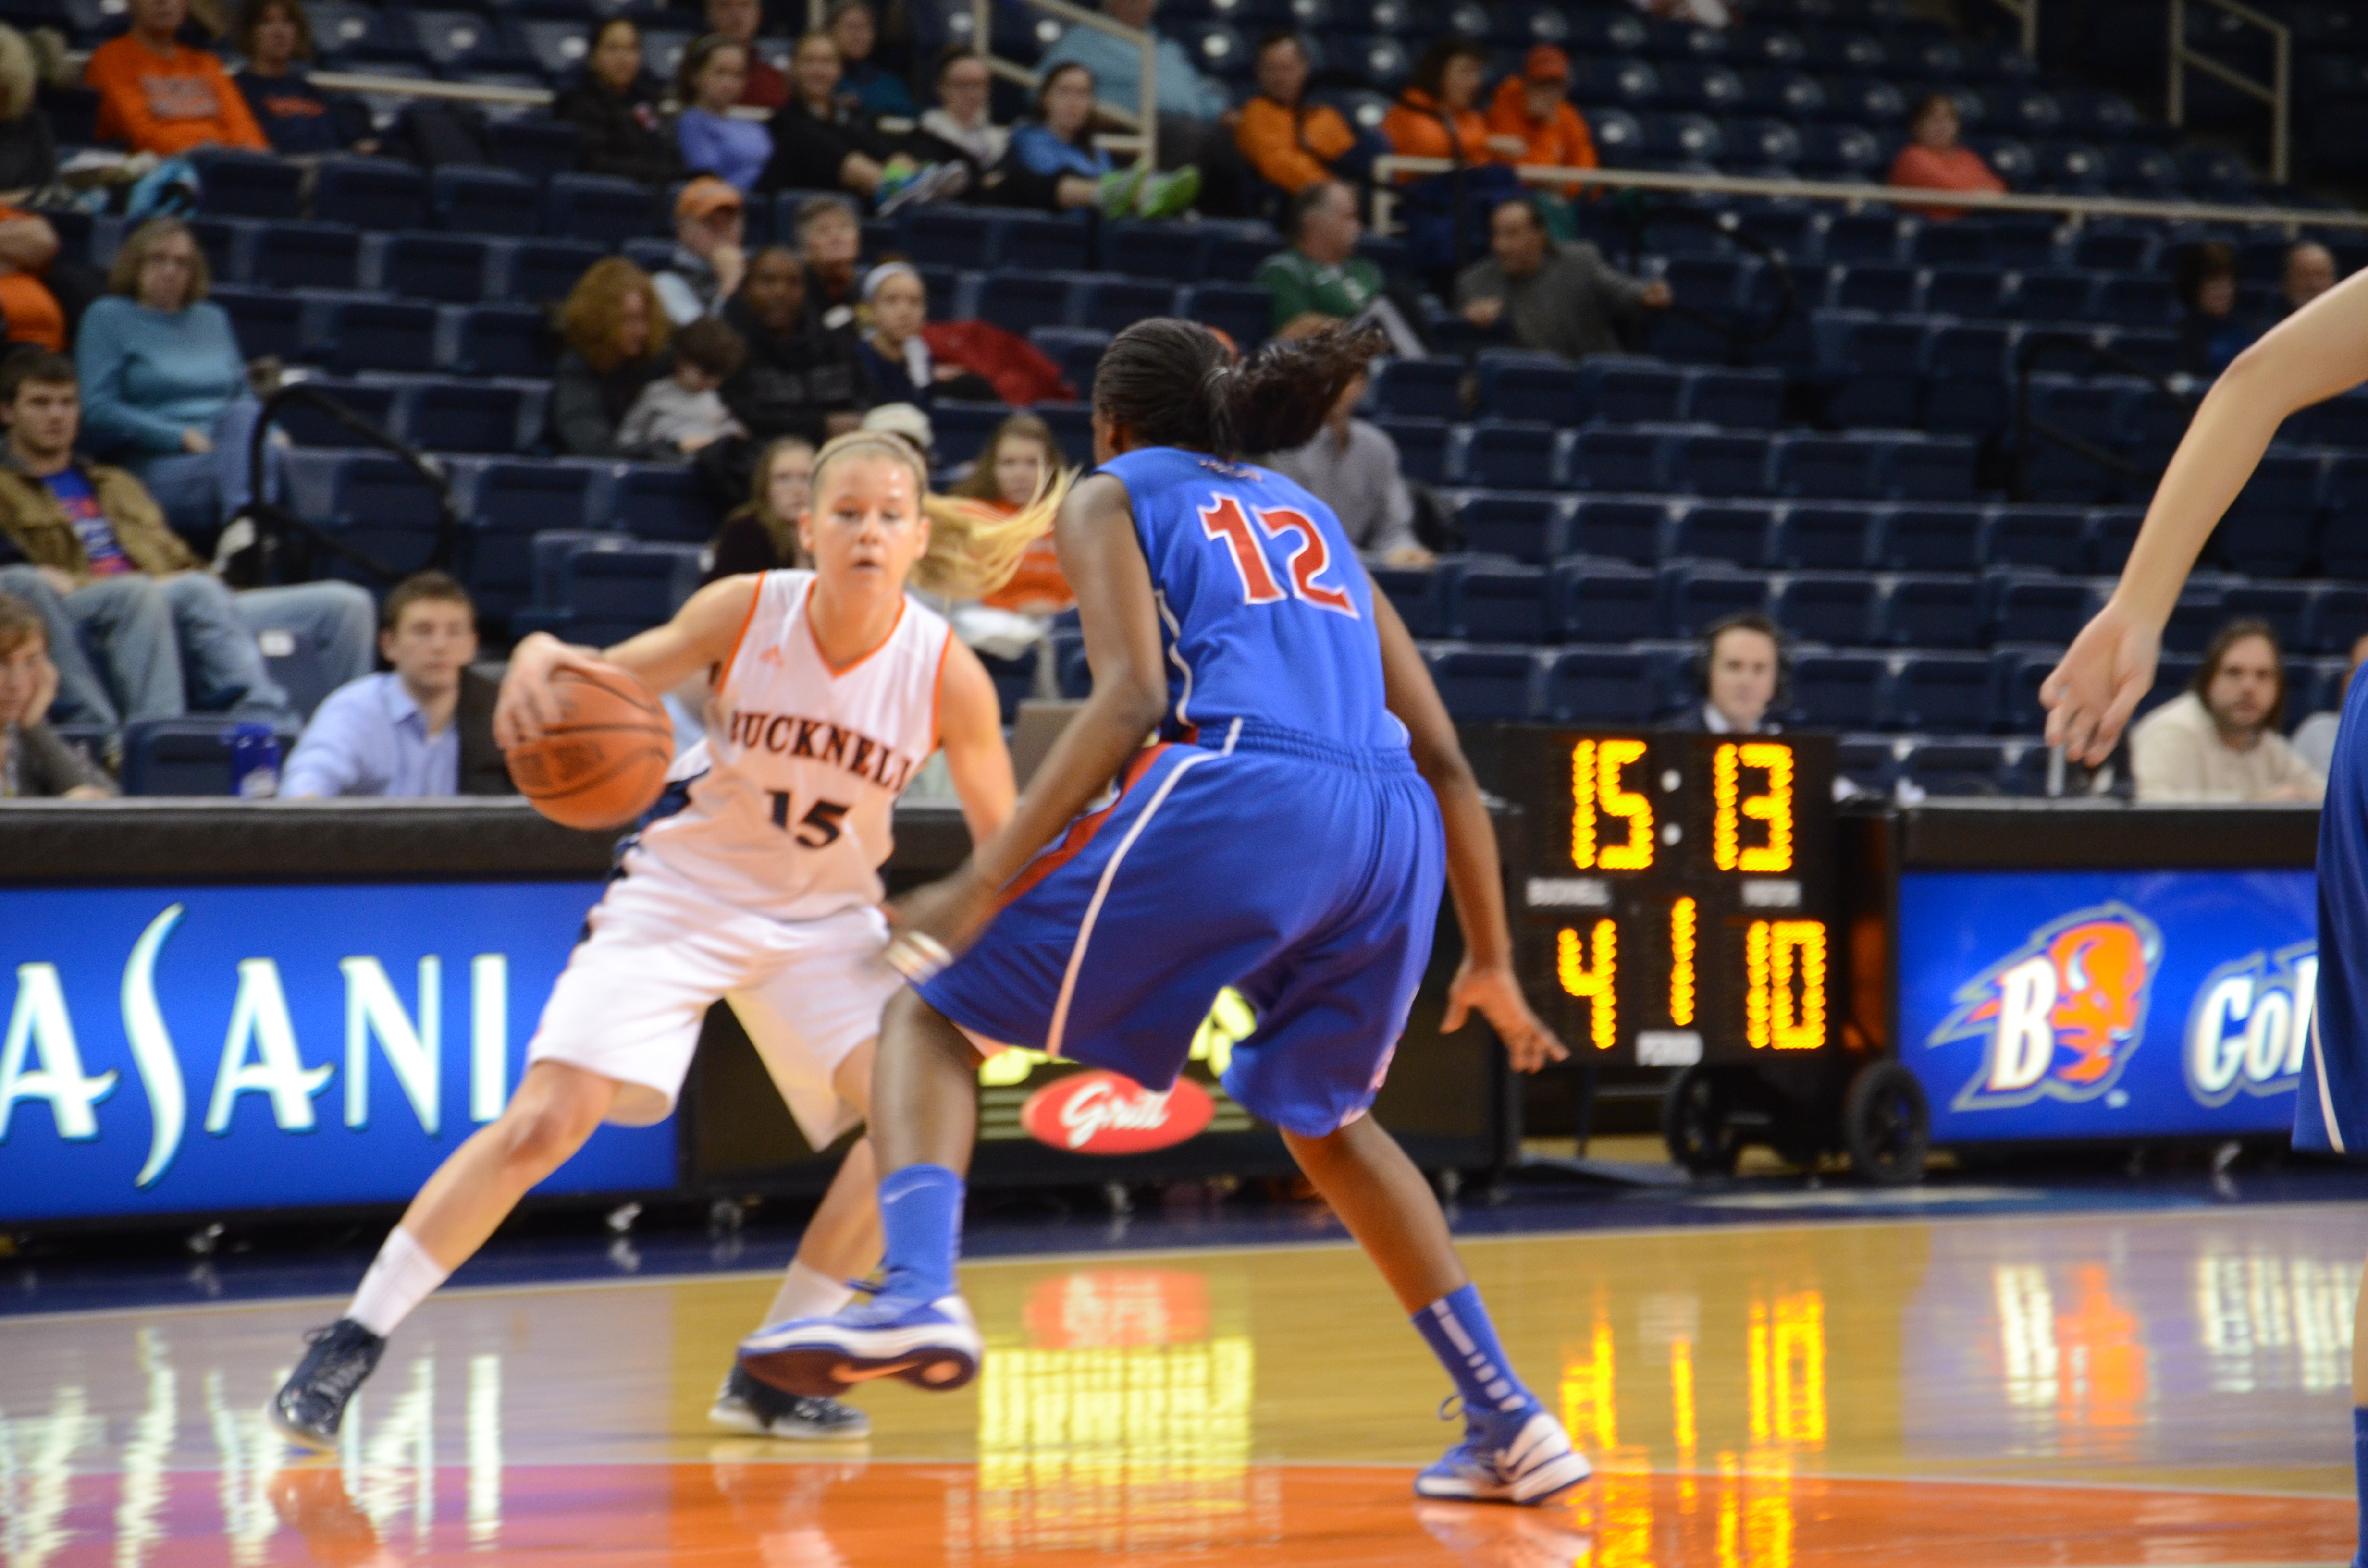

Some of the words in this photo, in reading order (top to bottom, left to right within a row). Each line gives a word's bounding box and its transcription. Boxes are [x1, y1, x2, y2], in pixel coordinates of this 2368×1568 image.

[1196, 491, 1361, 620] 12
[764, 789, 852, 849] 15
[1557, 919, 1616, 1049] 4
[1670, 896, 1696, 1026] 1
[1747, 920, 1825, 1049] 10
[1986, 955, 2059, 1093] B
[1060, 1081, 1171, 1149] Grill
